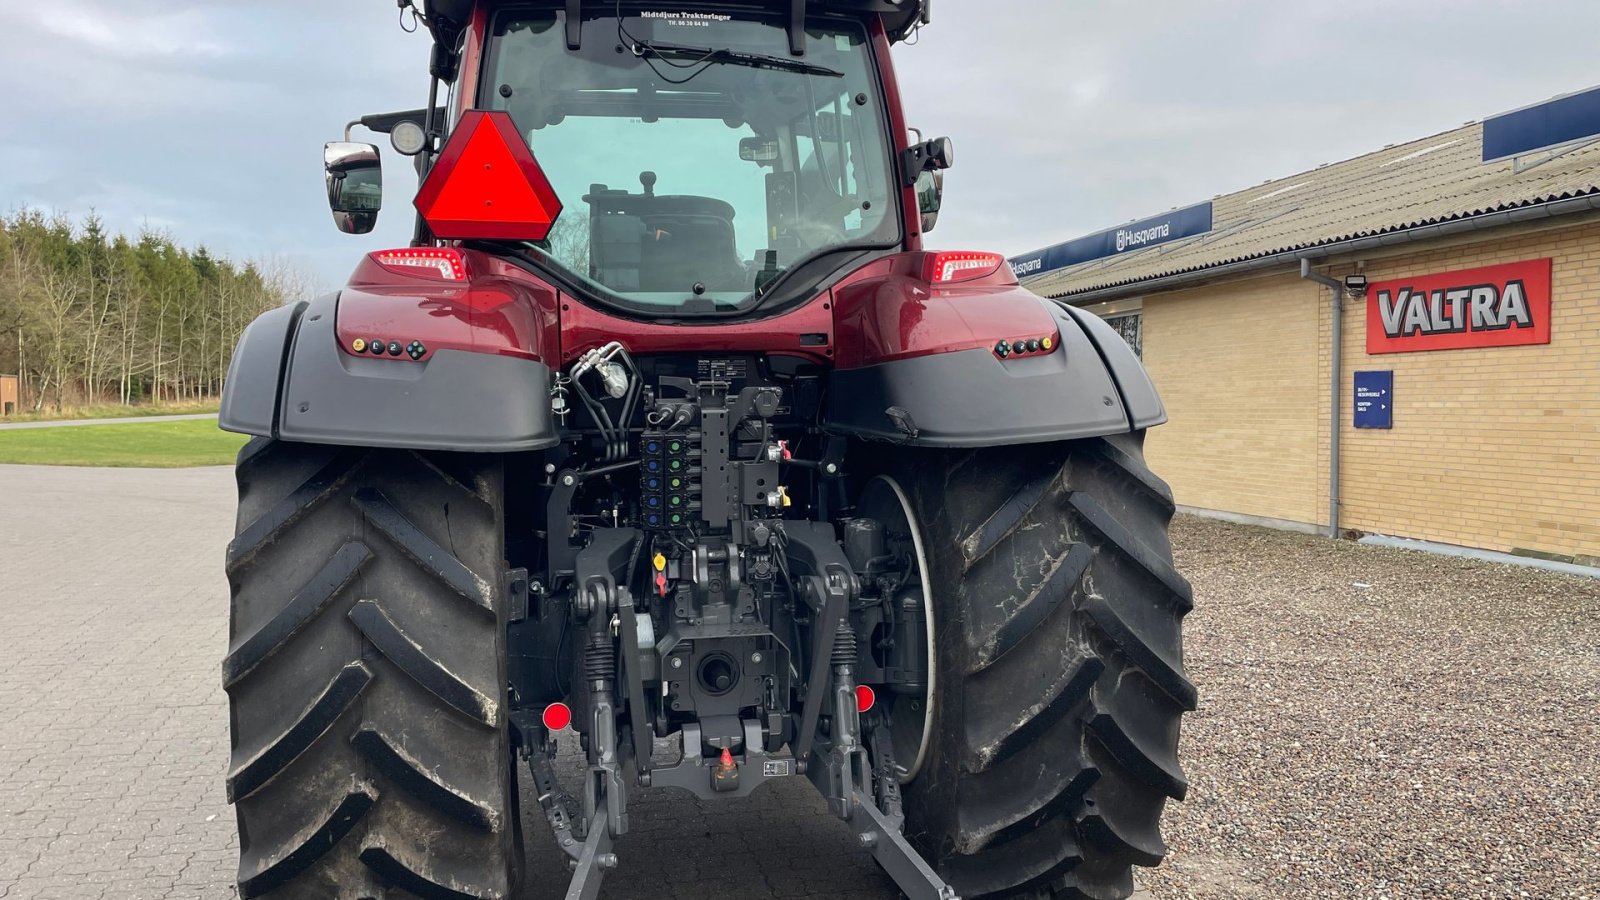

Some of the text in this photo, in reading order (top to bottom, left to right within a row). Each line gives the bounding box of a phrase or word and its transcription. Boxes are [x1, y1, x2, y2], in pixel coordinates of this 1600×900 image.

[640, 11, 732, 21] Midtdjurs Traktorlager
[1125, 223, 1169, 247] Husqvarna
[1376, 278, 1535, 339] VALTRA
